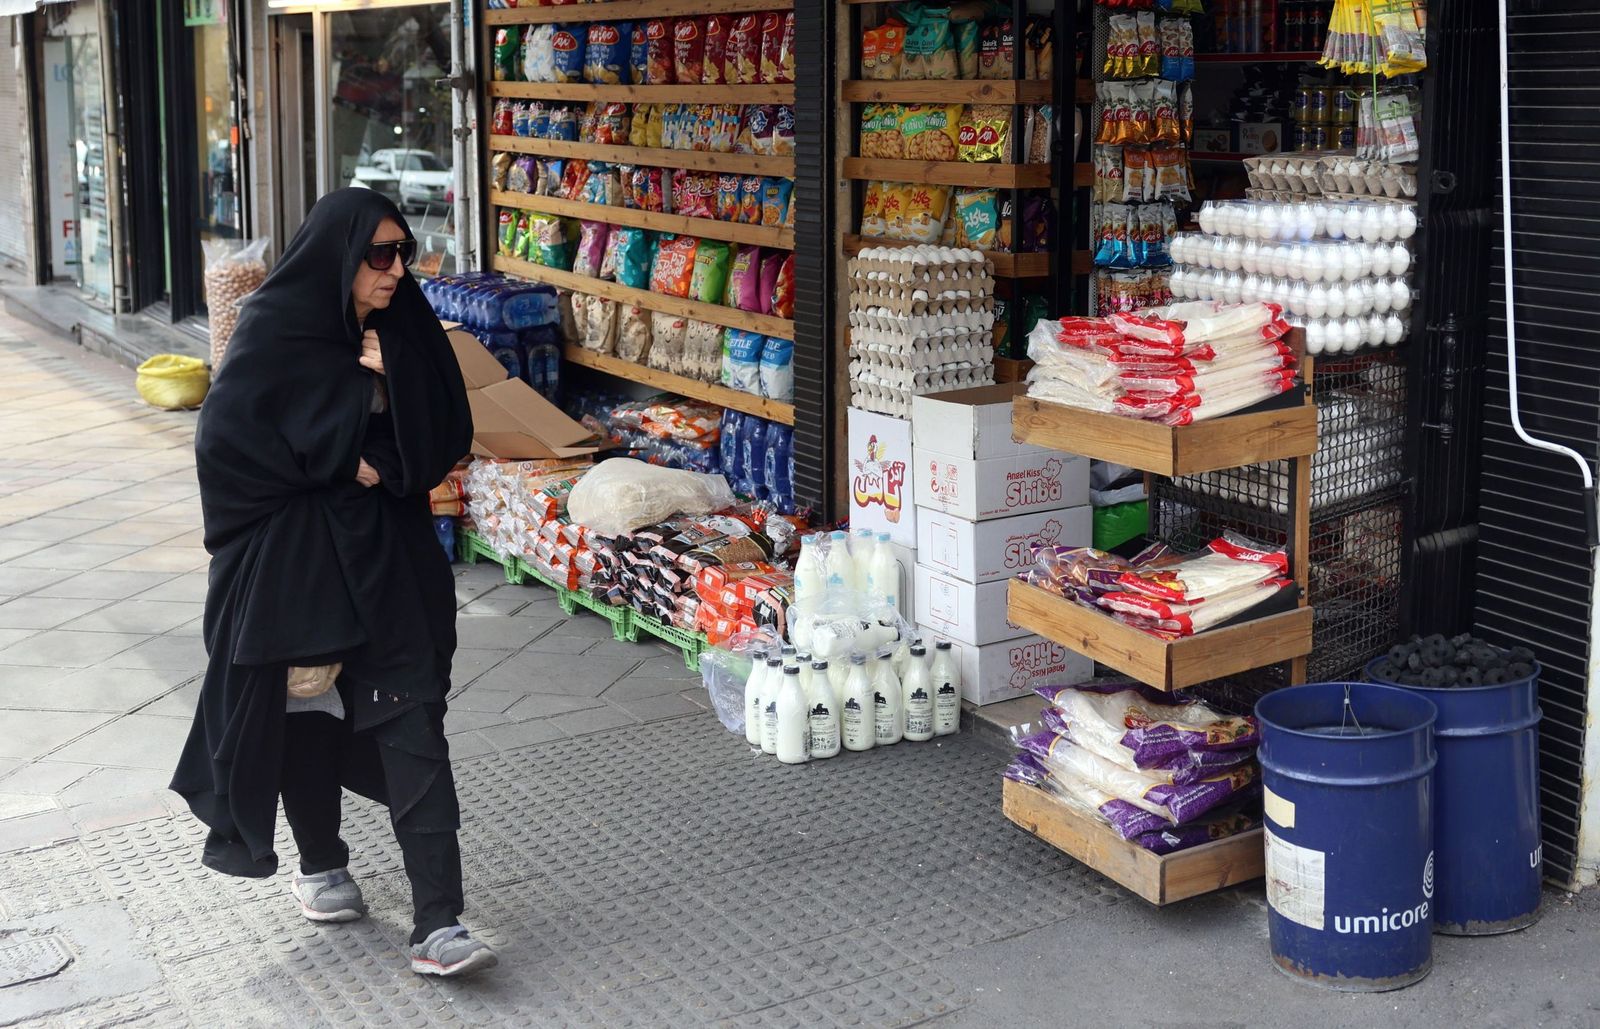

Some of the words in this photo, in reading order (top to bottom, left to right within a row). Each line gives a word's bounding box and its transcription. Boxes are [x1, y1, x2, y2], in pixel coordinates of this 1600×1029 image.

[1006, 470, 1026, 481] Angel
[1026, 468, 1041, 478] Kiss
[1005, 479, 1063, 508] Shiba
[1009, 640, 1066, 666] Shiba
[1031, 667, 1047, 678] Kiss
[1046, 664, 1066, 677] Angel
[1334, 900, 1429, 934] umicore
